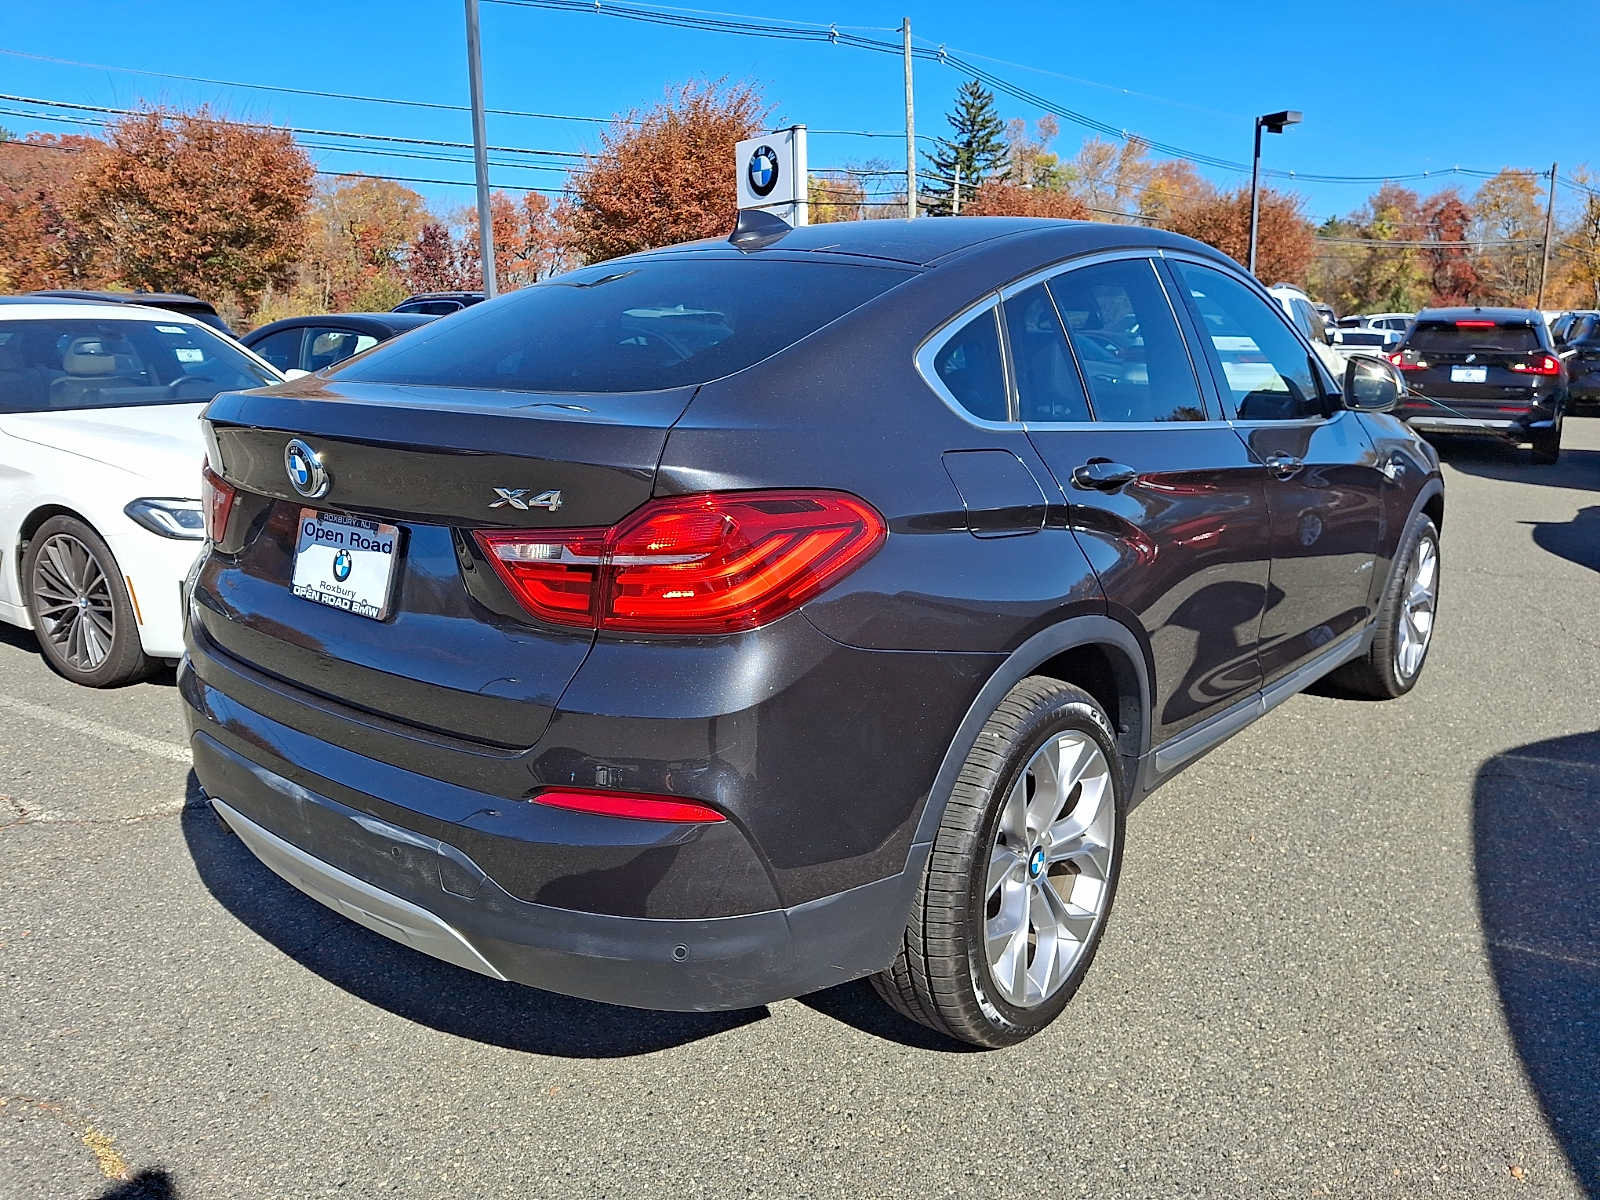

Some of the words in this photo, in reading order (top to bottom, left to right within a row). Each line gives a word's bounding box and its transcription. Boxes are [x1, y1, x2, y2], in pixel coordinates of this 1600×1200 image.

[750, 146, 775, 166] BMW
[488, 487, 562, 512] X4
[304, 521, 344, 541] Open
[349, 532, 393, 554] Road
[293, 585, 320, 600] OPEN
[321, 594, 351, 610] ROAD
[351, 602, 379, 618] BMW
[319, 580, 357, 600] Roxbury
